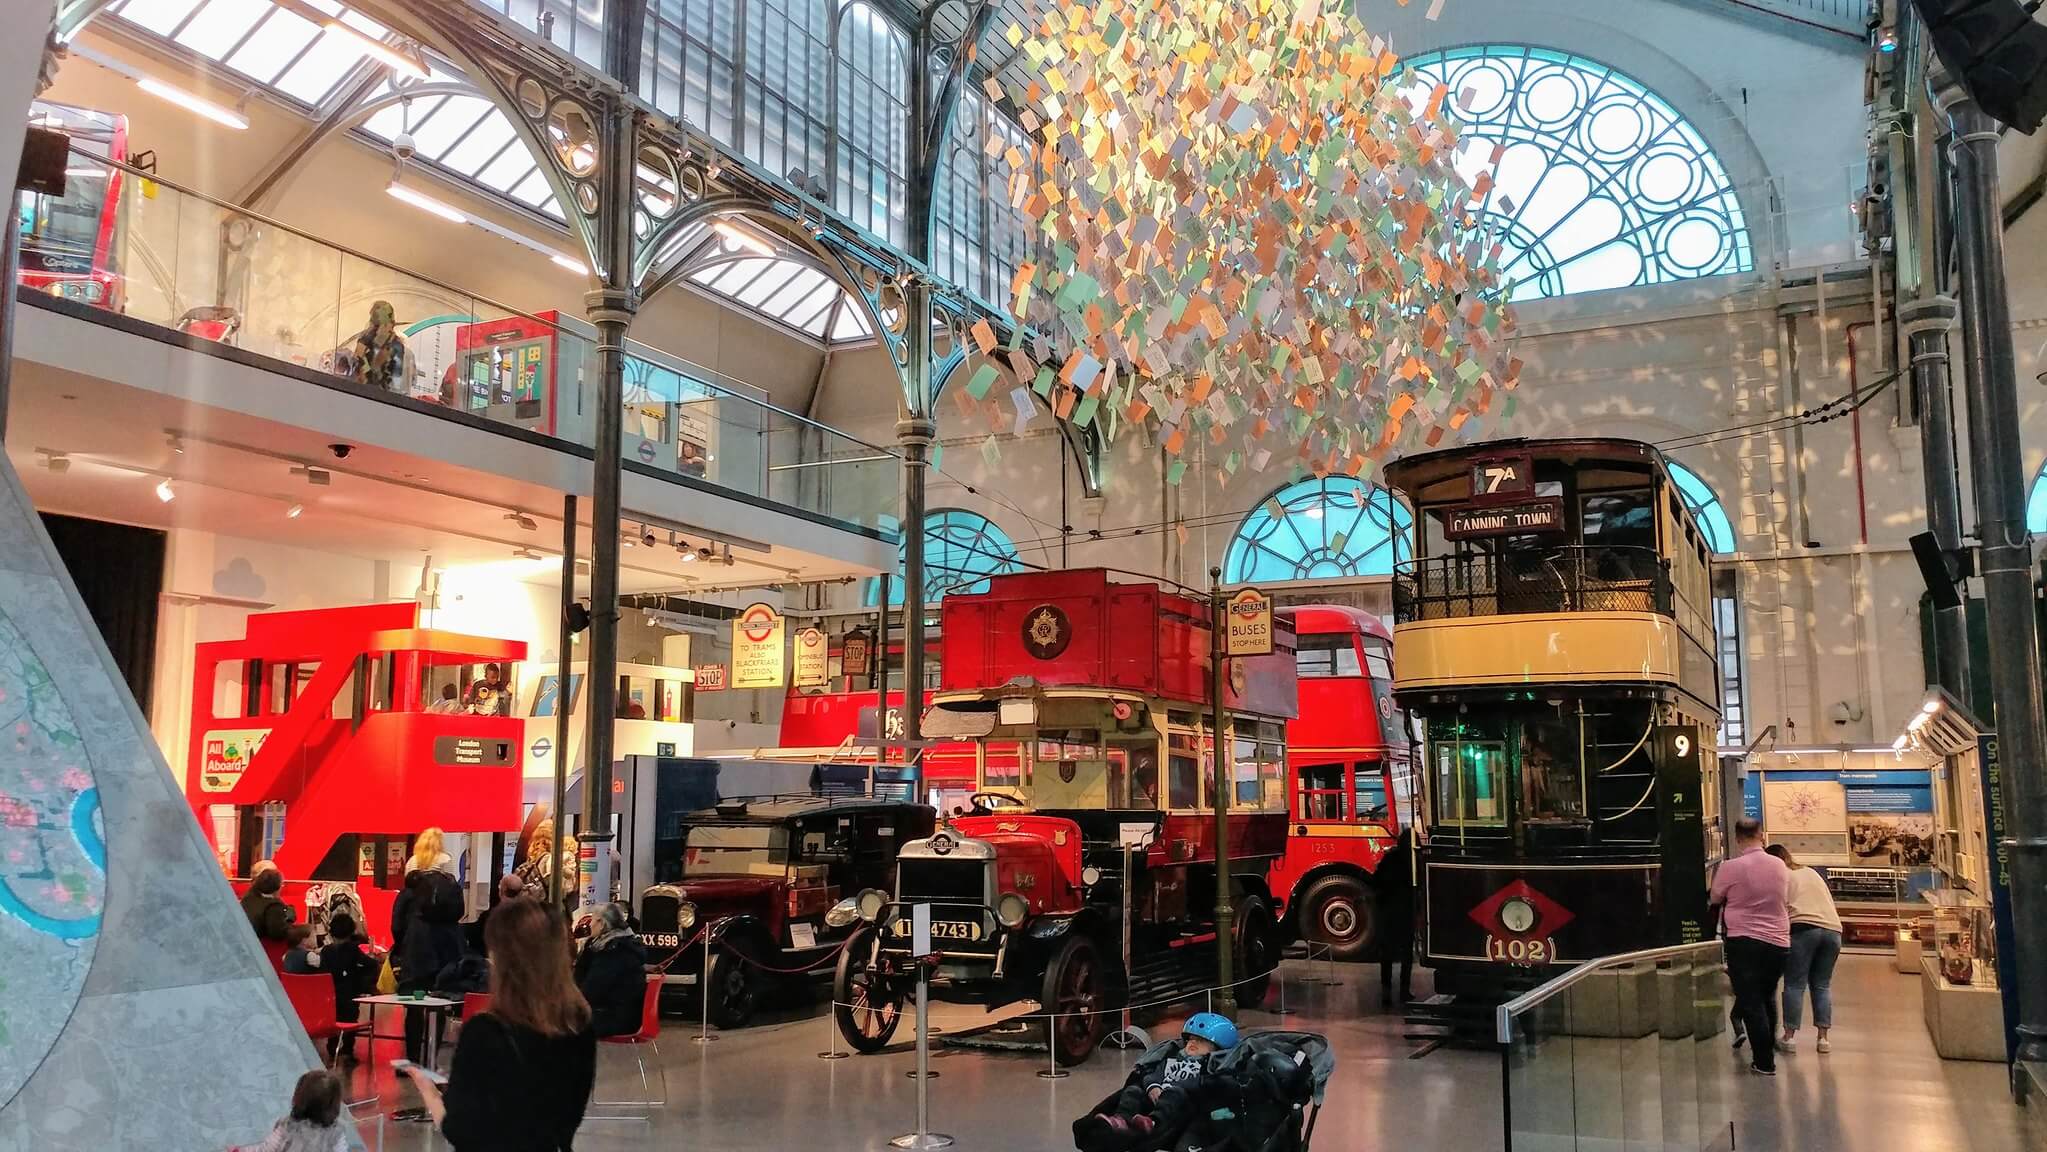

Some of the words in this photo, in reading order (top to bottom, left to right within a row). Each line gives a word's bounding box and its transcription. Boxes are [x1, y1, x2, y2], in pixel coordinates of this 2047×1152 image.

[1485, 466, 1517, 494] 7A
[1514, 511, 1552, 526] TOWN
[1231, 601, 1268, 615] GENERAL
[1232, 623, 1267, 637] BUSES
[740, 644, 750, 652] TO
[752, 643, 776, 651] TRAMS
[1232, 640, 1249, 648] STOP
[1250, 638, 1267, 647] HERE
[846, 646, 864, 660] STOP
[736, 658, 779, 668] BLACKFRIARS
[699, 669, 722, 685] STOP
[742, 668, 773, 677] STATION
[207, 743, 222, 755] All
[458, 739, 480, 747] London
[1674, 734, 1690, 758] 9
[1986, 741, 1997, 759] On
[455, 747, 483, 757] Transport
[207, 759, 242, 772] Aboard
[456, 755, 481, 764] Museum
[1988, 762, 2000, 784] the
[1311, 842, 1336, 854] 1253
[930, 921, 968, 938] 4743
[657, 933, 679, 947] 598
[1494, 939, 1546, 961] 102
